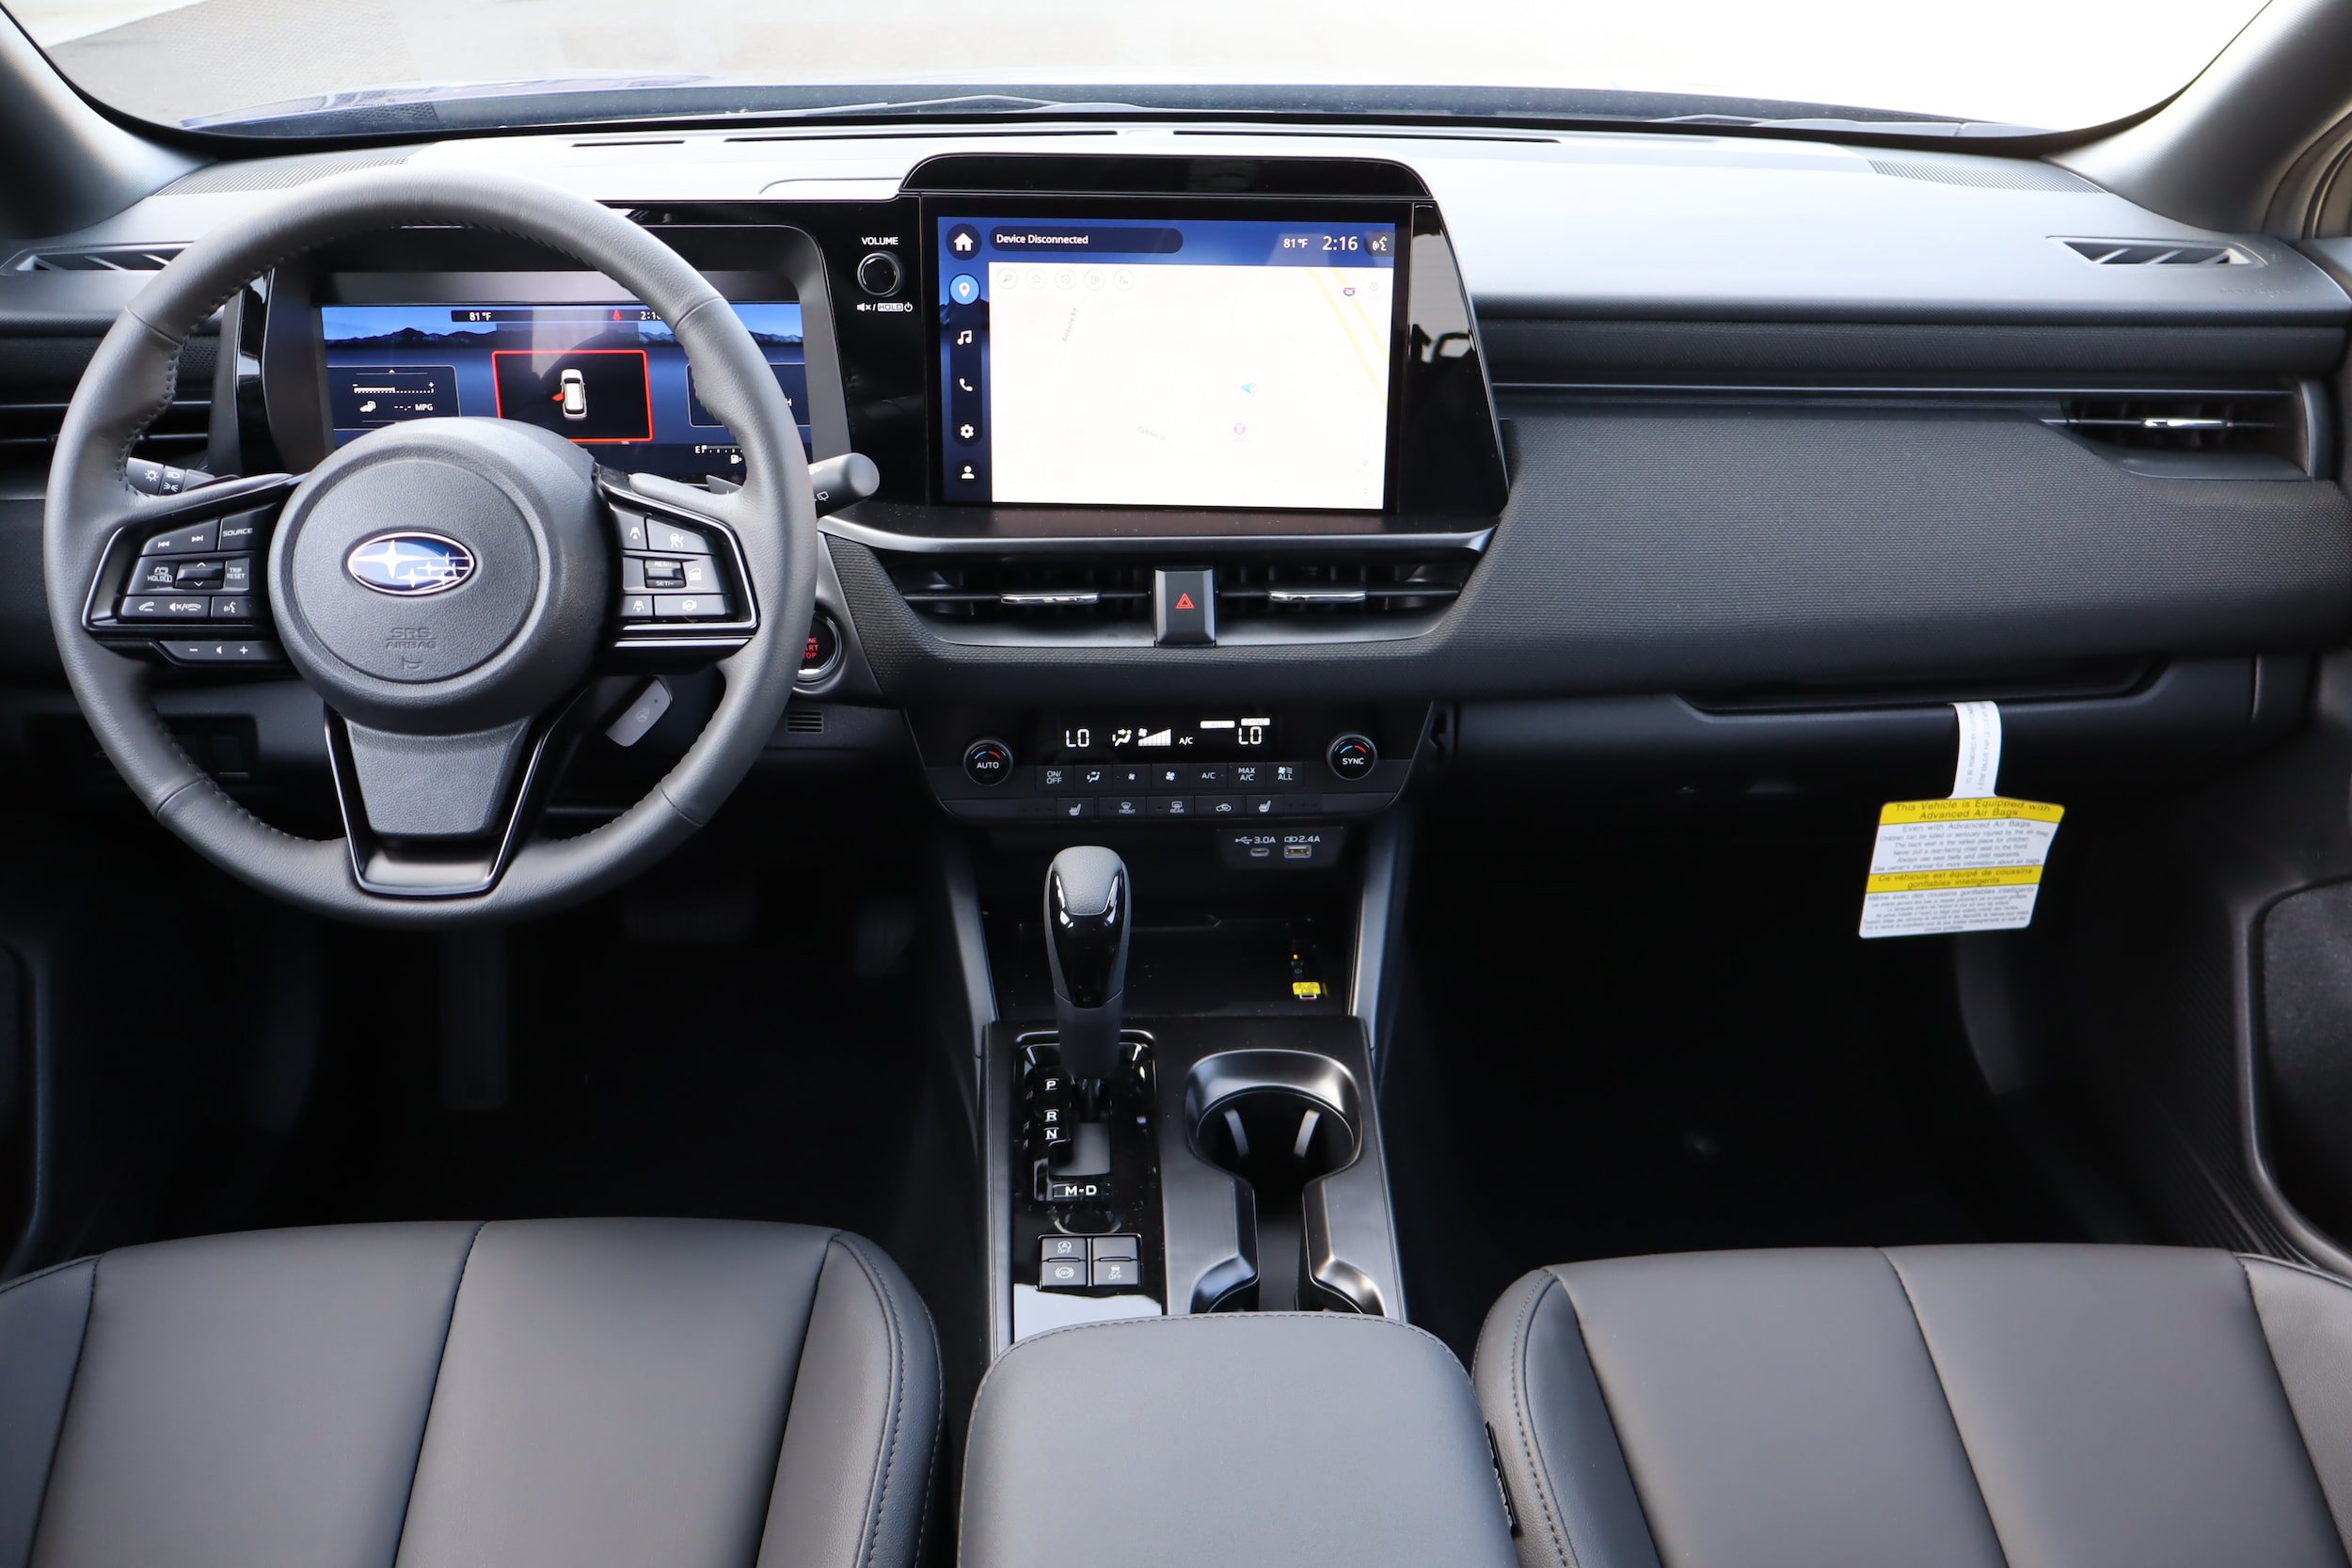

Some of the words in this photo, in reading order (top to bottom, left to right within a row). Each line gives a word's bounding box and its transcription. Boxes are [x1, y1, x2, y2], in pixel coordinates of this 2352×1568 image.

[861, 236, 899, 245] VOLUME
[995, 234, 1025, 244] Device
[1027, 234, 1089, 245] Disconnected
[1322, 235, 1359, 250] 2:16
[222, 528, 254, 537] SOURCE
[390, 626, 433, 639] SRS
[385, 641, 437, 649] AIRBAG
[1065, 728, 1090, 748] LO
[1179, 736, 1194, 745] A/C
[1238, 726, 1263, 745] LO
[976, 761, 1000, 769] AUTO
[1201, 771, 1216, 780] A/C
[1239, 773, 1255, 782] A/C
[1896, 802, 1916, 813] This
[1921, 800, 1957, 810] Vehicle
[1975, 799, 2025, 809] Equipped
[1919, 810, 1970, 820] Advanced
[1992, 807, 2018, 818] Bags
[1947, 821, 1990, 830] Advanced
[2009, 819, 2030, 829] Bags
[1878, 874, 1891, 882] Ce
[1894, 872, 1930, 881] véhicule
[1932, 871, 1947, 879] est
[1995, 867, 2033, 876] coussins
[1954, 876, 2001, 886] intelligents
[1046, 1080, 1057, 1090] P
[1046, 1111, 1057, 1122] R
[1046, 1129, 1057, 1139] N
[1064, 1184, 1097, 1196] M-D
